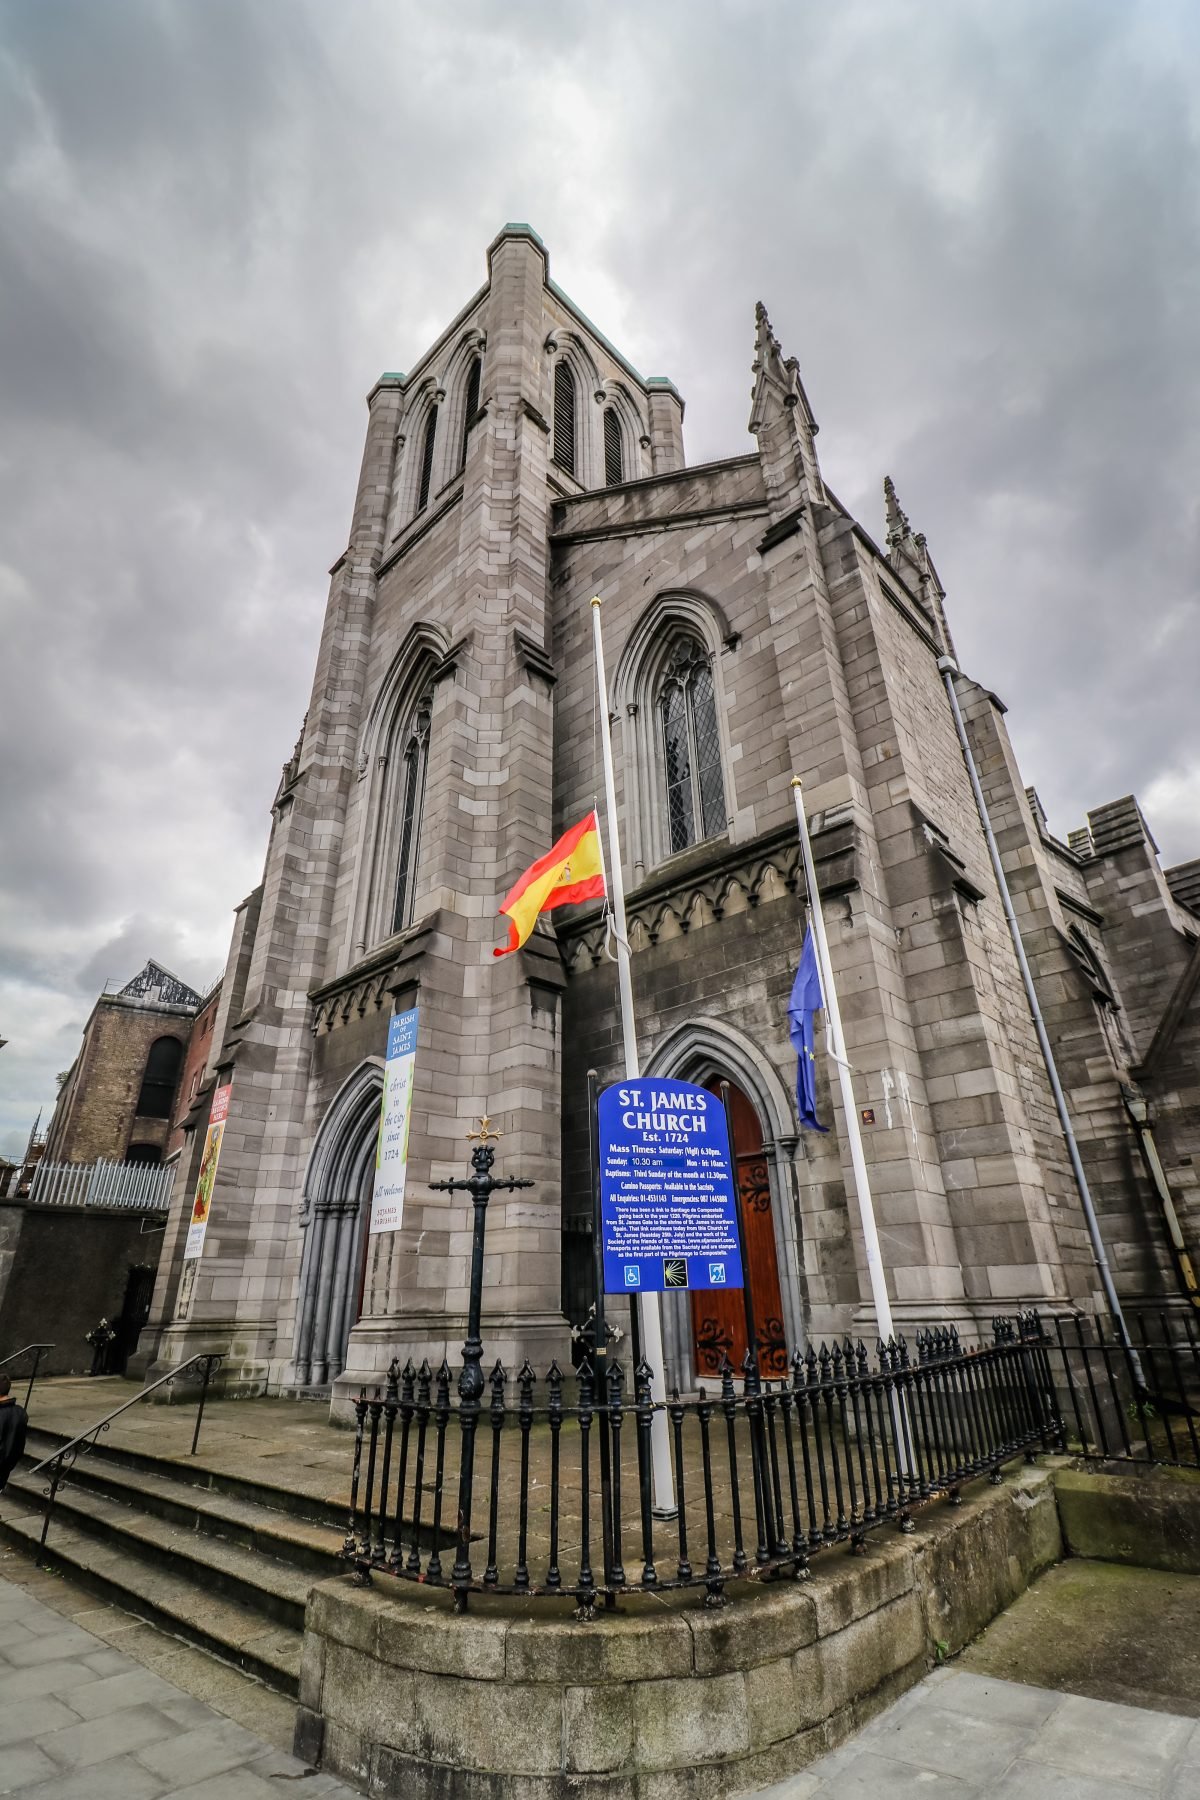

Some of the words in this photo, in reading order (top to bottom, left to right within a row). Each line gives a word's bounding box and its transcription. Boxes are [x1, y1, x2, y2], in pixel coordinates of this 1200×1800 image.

[393, 1014, 415, 1029] PARISH
[393, 1031, 412, 1046] SAINT
[391, 1042, 410, 1057] JAMES
[394, 1097, 400, 1108] in
[619, 1090, 644, 1107] ST.
[651, 1092, 706, 1112] JAMES
[622, 1112, 706, 1132] CHURCH
[643, 1132, 661, 1142] Est.
[665, 1133, 688, 1142] 1724
[384, 1149, 399, 1160] 1724
[610, 1144, 630, 1152] Mass
[632, 1145, 656, 1154] Times:
[658, 1146, 684, 1156] Saturday:
[701, 1148, 721, 1156] 6.30pm.
[607, 1157, 628, 1166] Sunday:
[605, 1169, 631, 1178] Baptisms:
[648, 1170, 666, 1179] Sunday
[639, 1182, 662, 1191] Passports:
[617, 1194, 640, 1204] Enquiries:
[672, 1195, 700, 1204] Emergencies:
